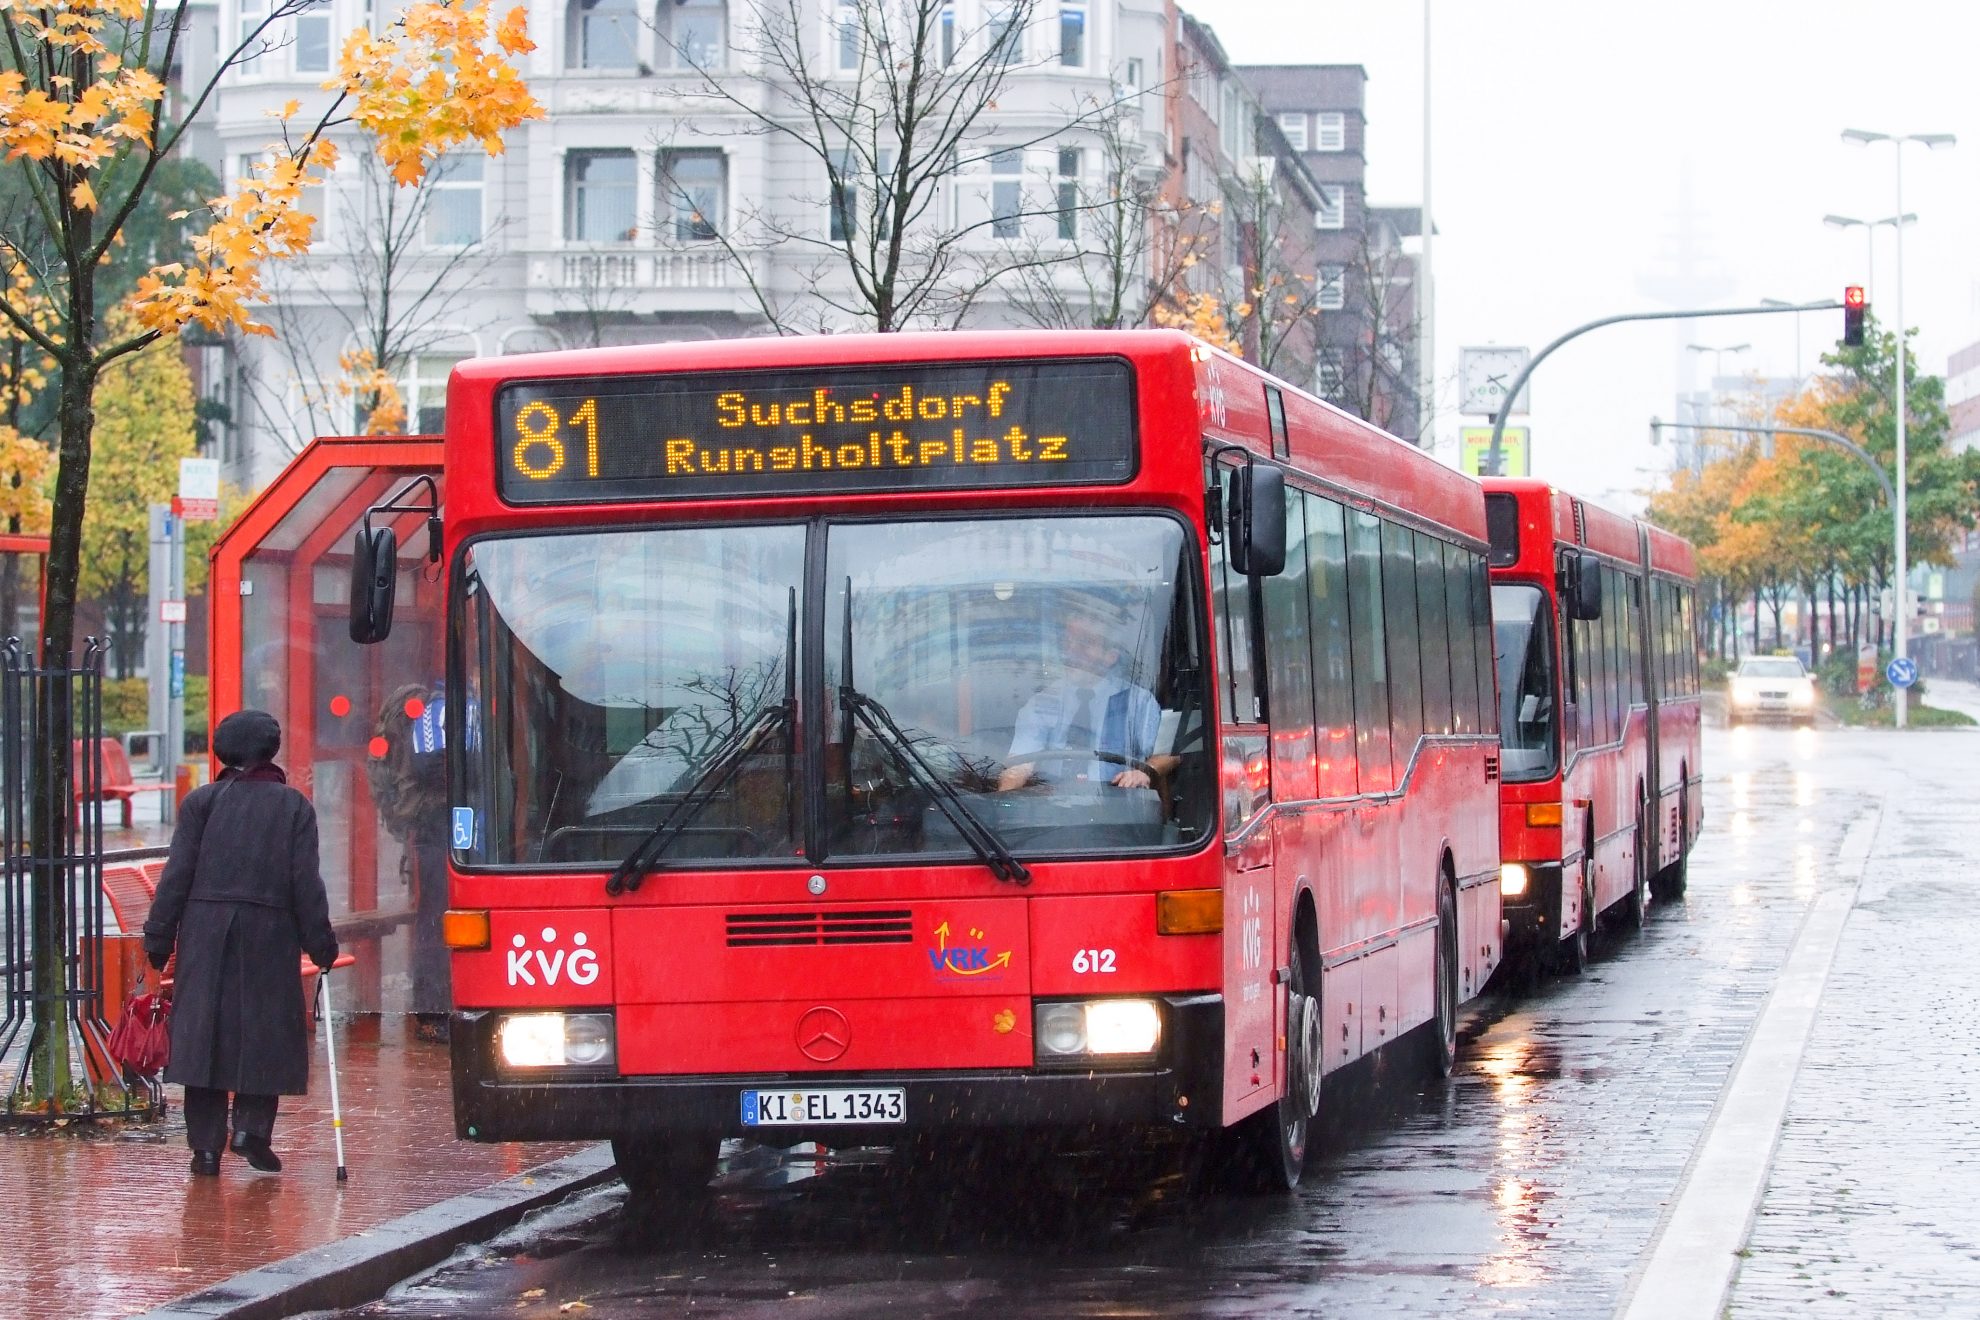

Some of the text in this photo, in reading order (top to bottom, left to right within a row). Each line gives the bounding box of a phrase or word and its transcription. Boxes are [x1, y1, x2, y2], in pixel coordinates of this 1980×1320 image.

[716, 382, 1012, 428] Suchsdorf
[514, 399, 599, 480] 81
[666, 426, 1069, 474] Rungholtplatz
[928, 947, 990, 971] VRK
[1071, 948, 1118, 974] 612
[1242, 916, 1261, 971] KVG
[506, 946, 600, 987] KVG
[758, 1093, 902, 1121] KI EL 1343
